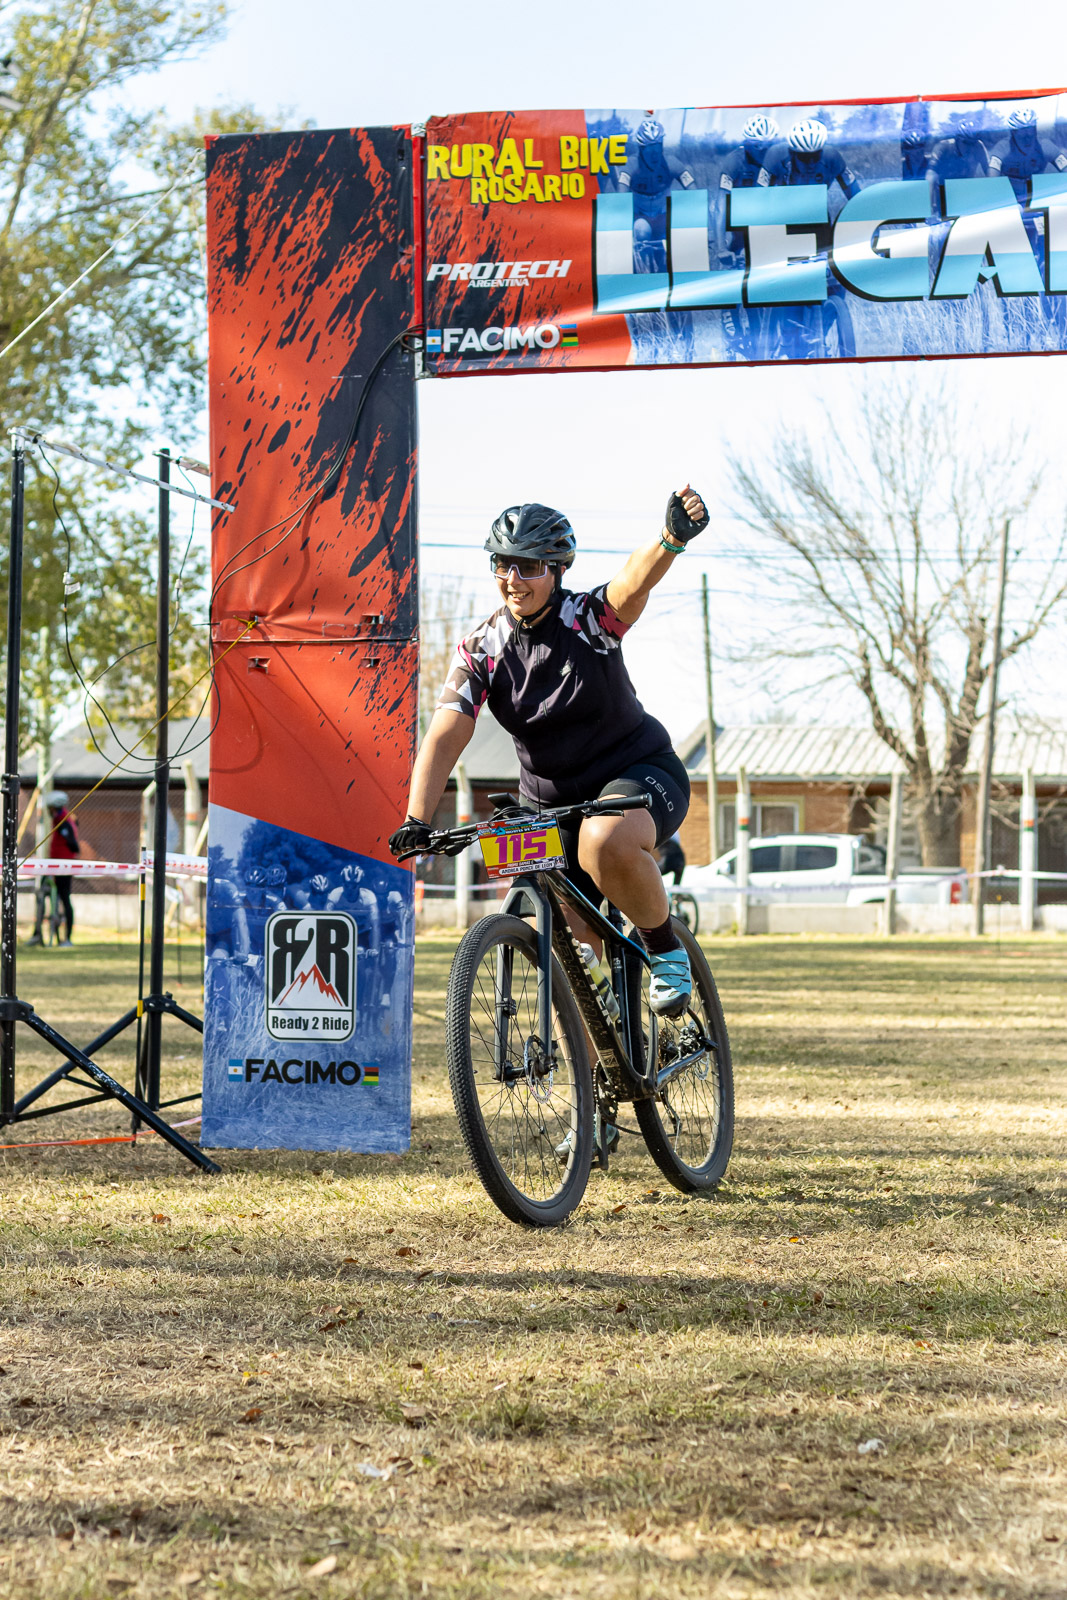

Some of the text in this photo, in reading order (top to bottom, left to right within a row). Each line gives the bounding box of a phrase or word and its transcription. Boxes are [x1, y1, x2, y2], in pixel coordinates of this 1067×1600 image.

[427, 134, 628, 180] RURAL BIKE
[471, 173, 586, 204] ROSARIO
[591, 173, 1067, 315] LLEGA
[426, 260, 572, 281] PROTECH
[467, 278, 530, 288] ARGENTINA
[443, 324, 560, 352] FACIMO
[645, 776, 674, 812] OSLO
[495, 830, 547, 864] 115
[271, 1016, 349, 1031] Ready 2 Ride
[245, 1058, 361, 1086] FACIMO
